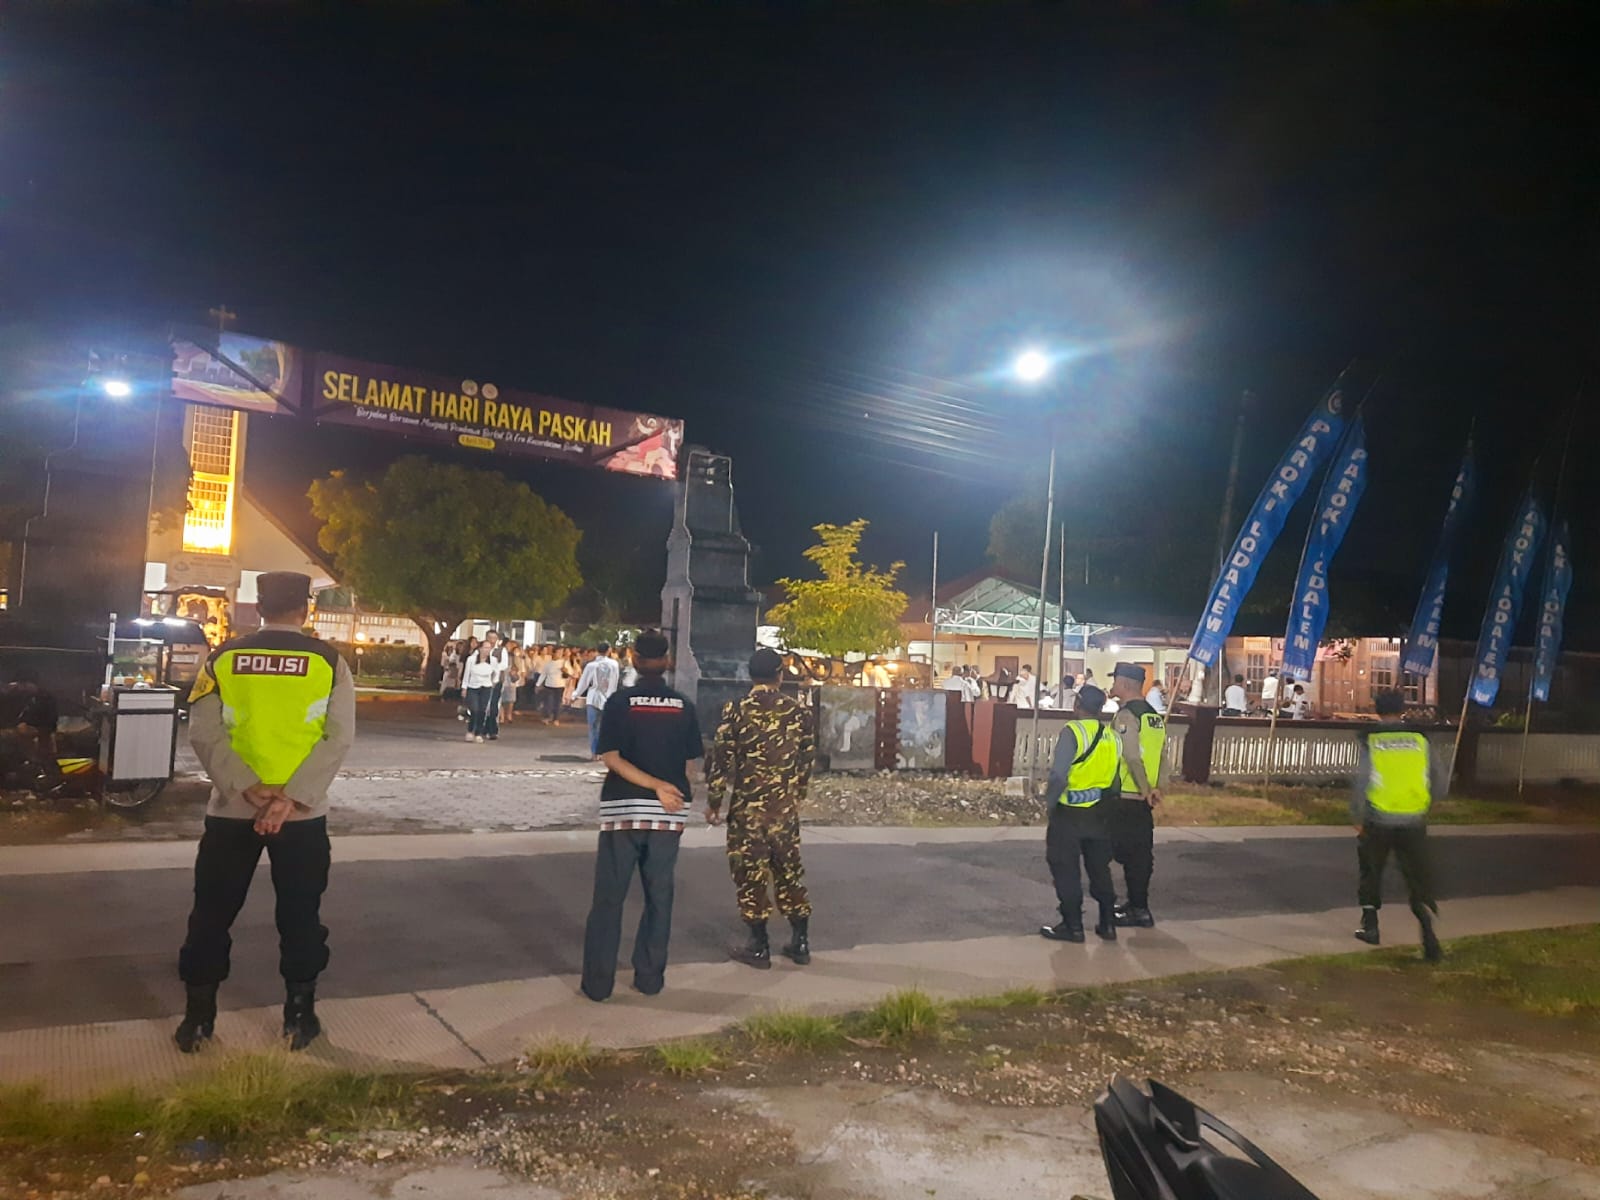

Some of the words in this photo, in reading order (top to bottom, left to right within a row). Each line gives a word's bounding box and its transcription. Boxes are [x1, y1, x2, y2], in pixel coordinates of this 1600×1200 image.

[322, 370, 426, 414] SELAMAT
[430, 389, 480, 424] HARI
[484, 400, 533, 433] RAYA
[538, 410, 612, 447] PASKAH
[1264, 419, 1330, 512] PAROKI
[1321, 448, 1367, 535] PAROKI
[1206, 521, 1262, 633] LODALEM
[236, 655, 305, 673] POLISI
